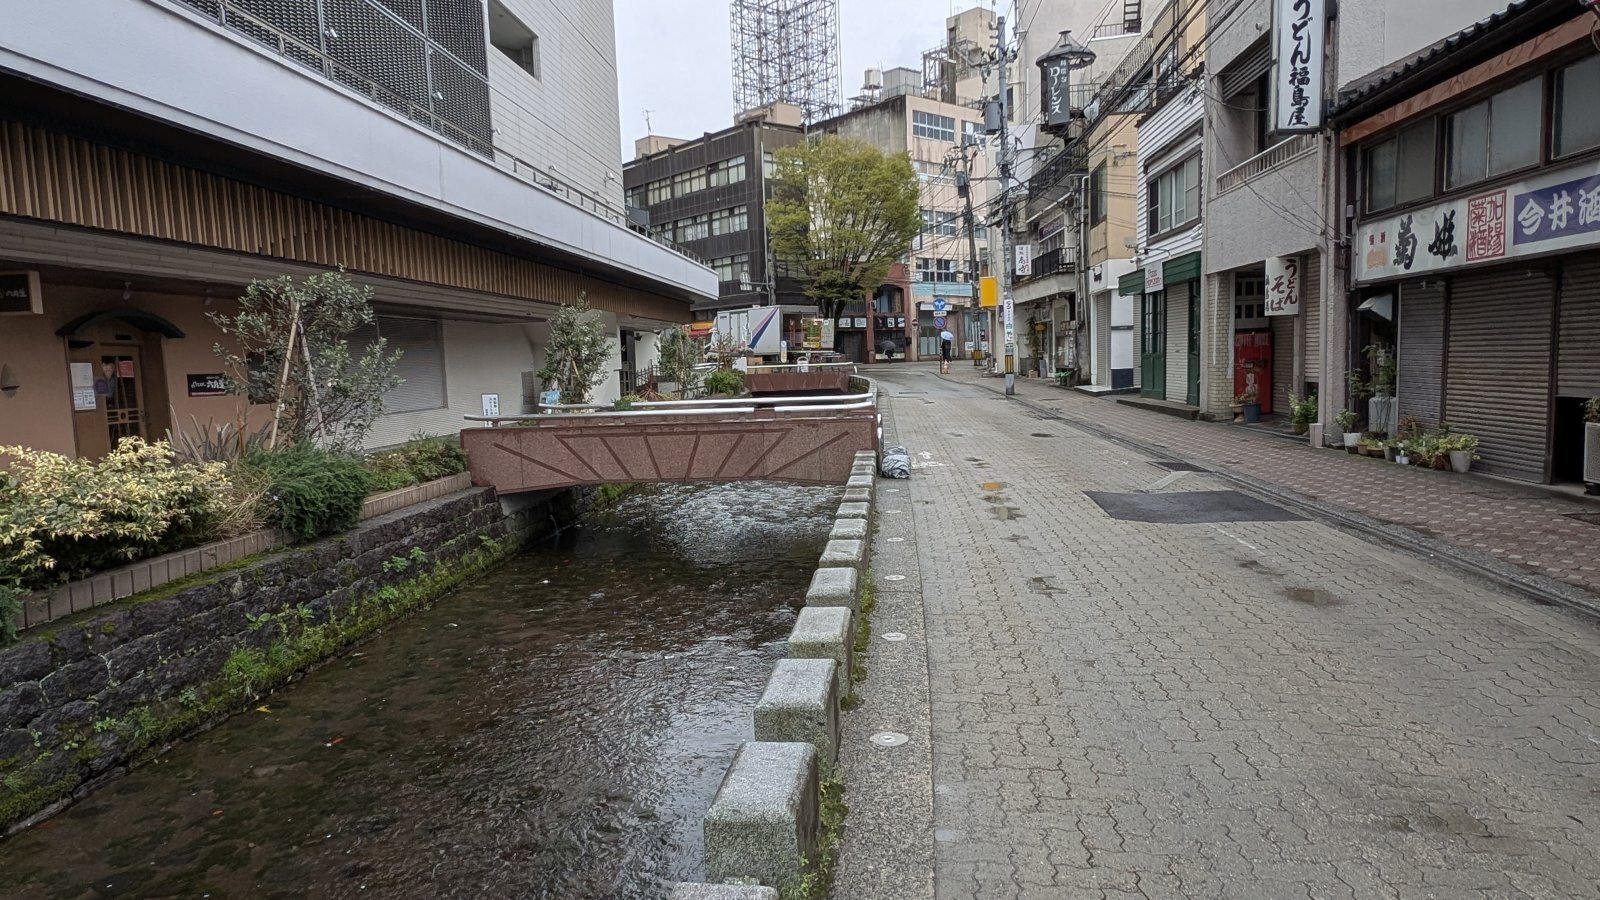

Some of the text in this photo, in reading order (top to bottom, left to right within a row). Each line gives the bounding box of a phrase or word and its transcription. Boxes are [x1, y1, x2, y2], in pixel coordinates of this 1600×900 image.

[1288, 0, 1313, 126] うどん福島屋
[1049, 66, 1062, 115] ローレンス
[1393, 208, 1458, 270] 菊姫
[1270, 275, 1285, 312] そば
[1284, 258, 1298, 305] うどん
